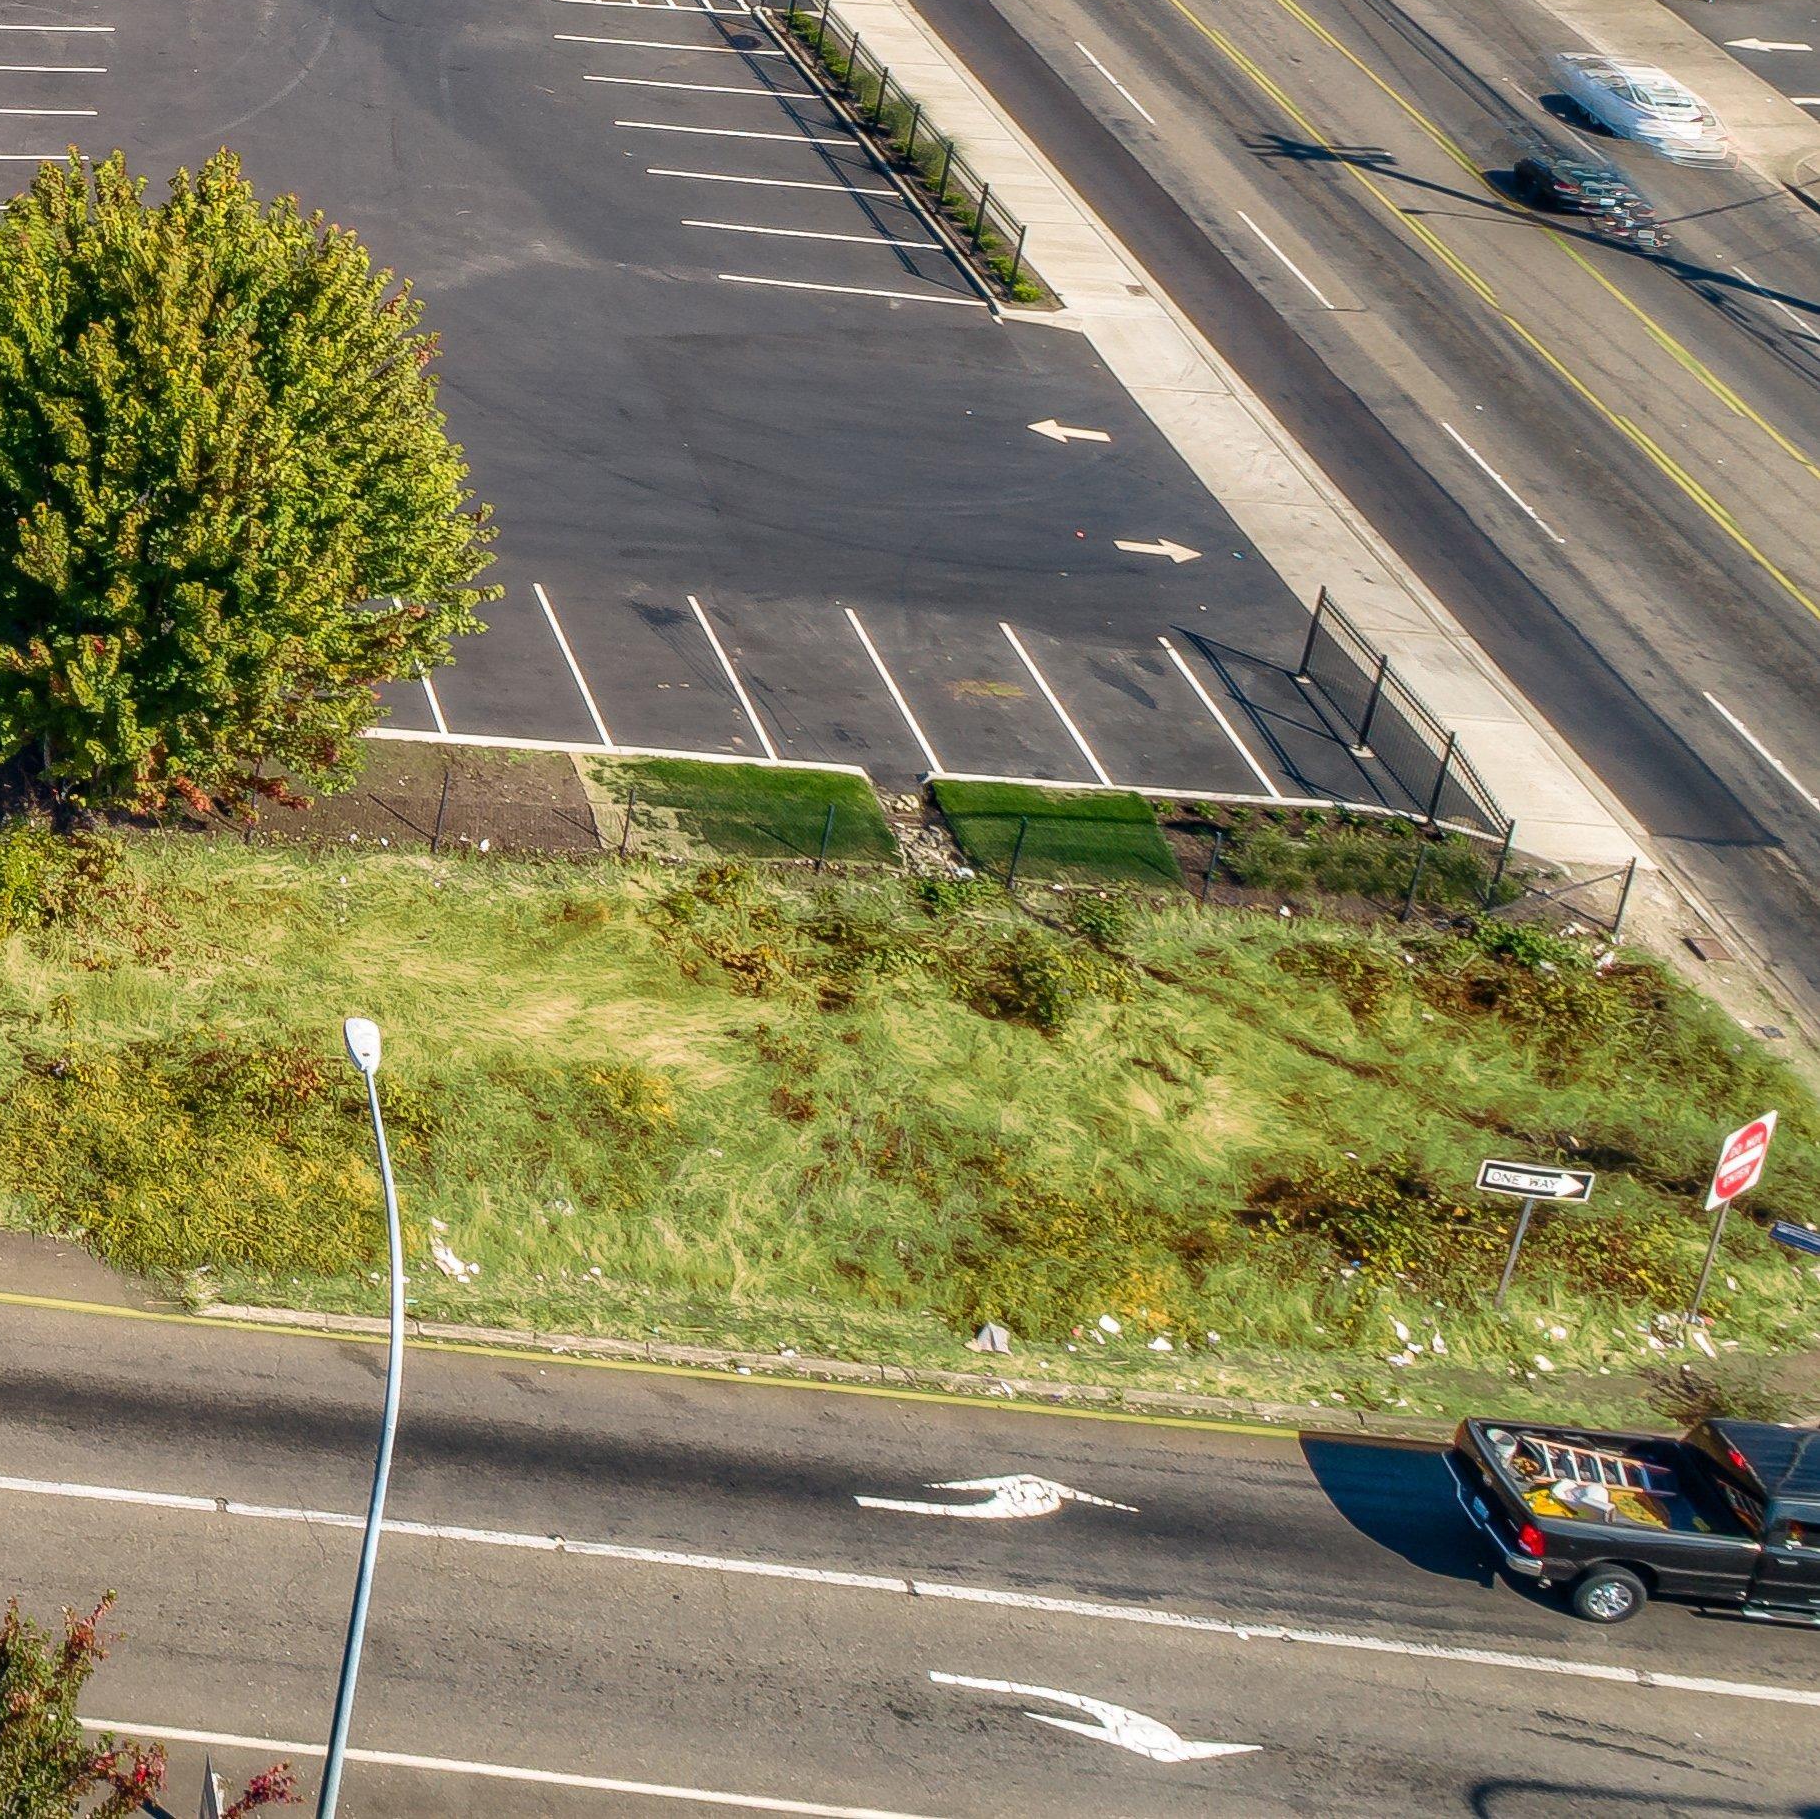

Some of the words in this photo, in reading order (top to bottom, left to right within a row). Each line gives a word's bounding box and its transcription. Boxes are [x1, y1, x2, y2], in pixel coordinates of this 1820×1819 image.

[1728, 1142, 1743, 1160] DO
[1745, 1131, 1763, 1150] NOT
[1491, 1171, 1522, 1186] ONE
[1529, 1177, 1559, 1189] WAY
[1722, 1164, 1752, 1188] ENTER
